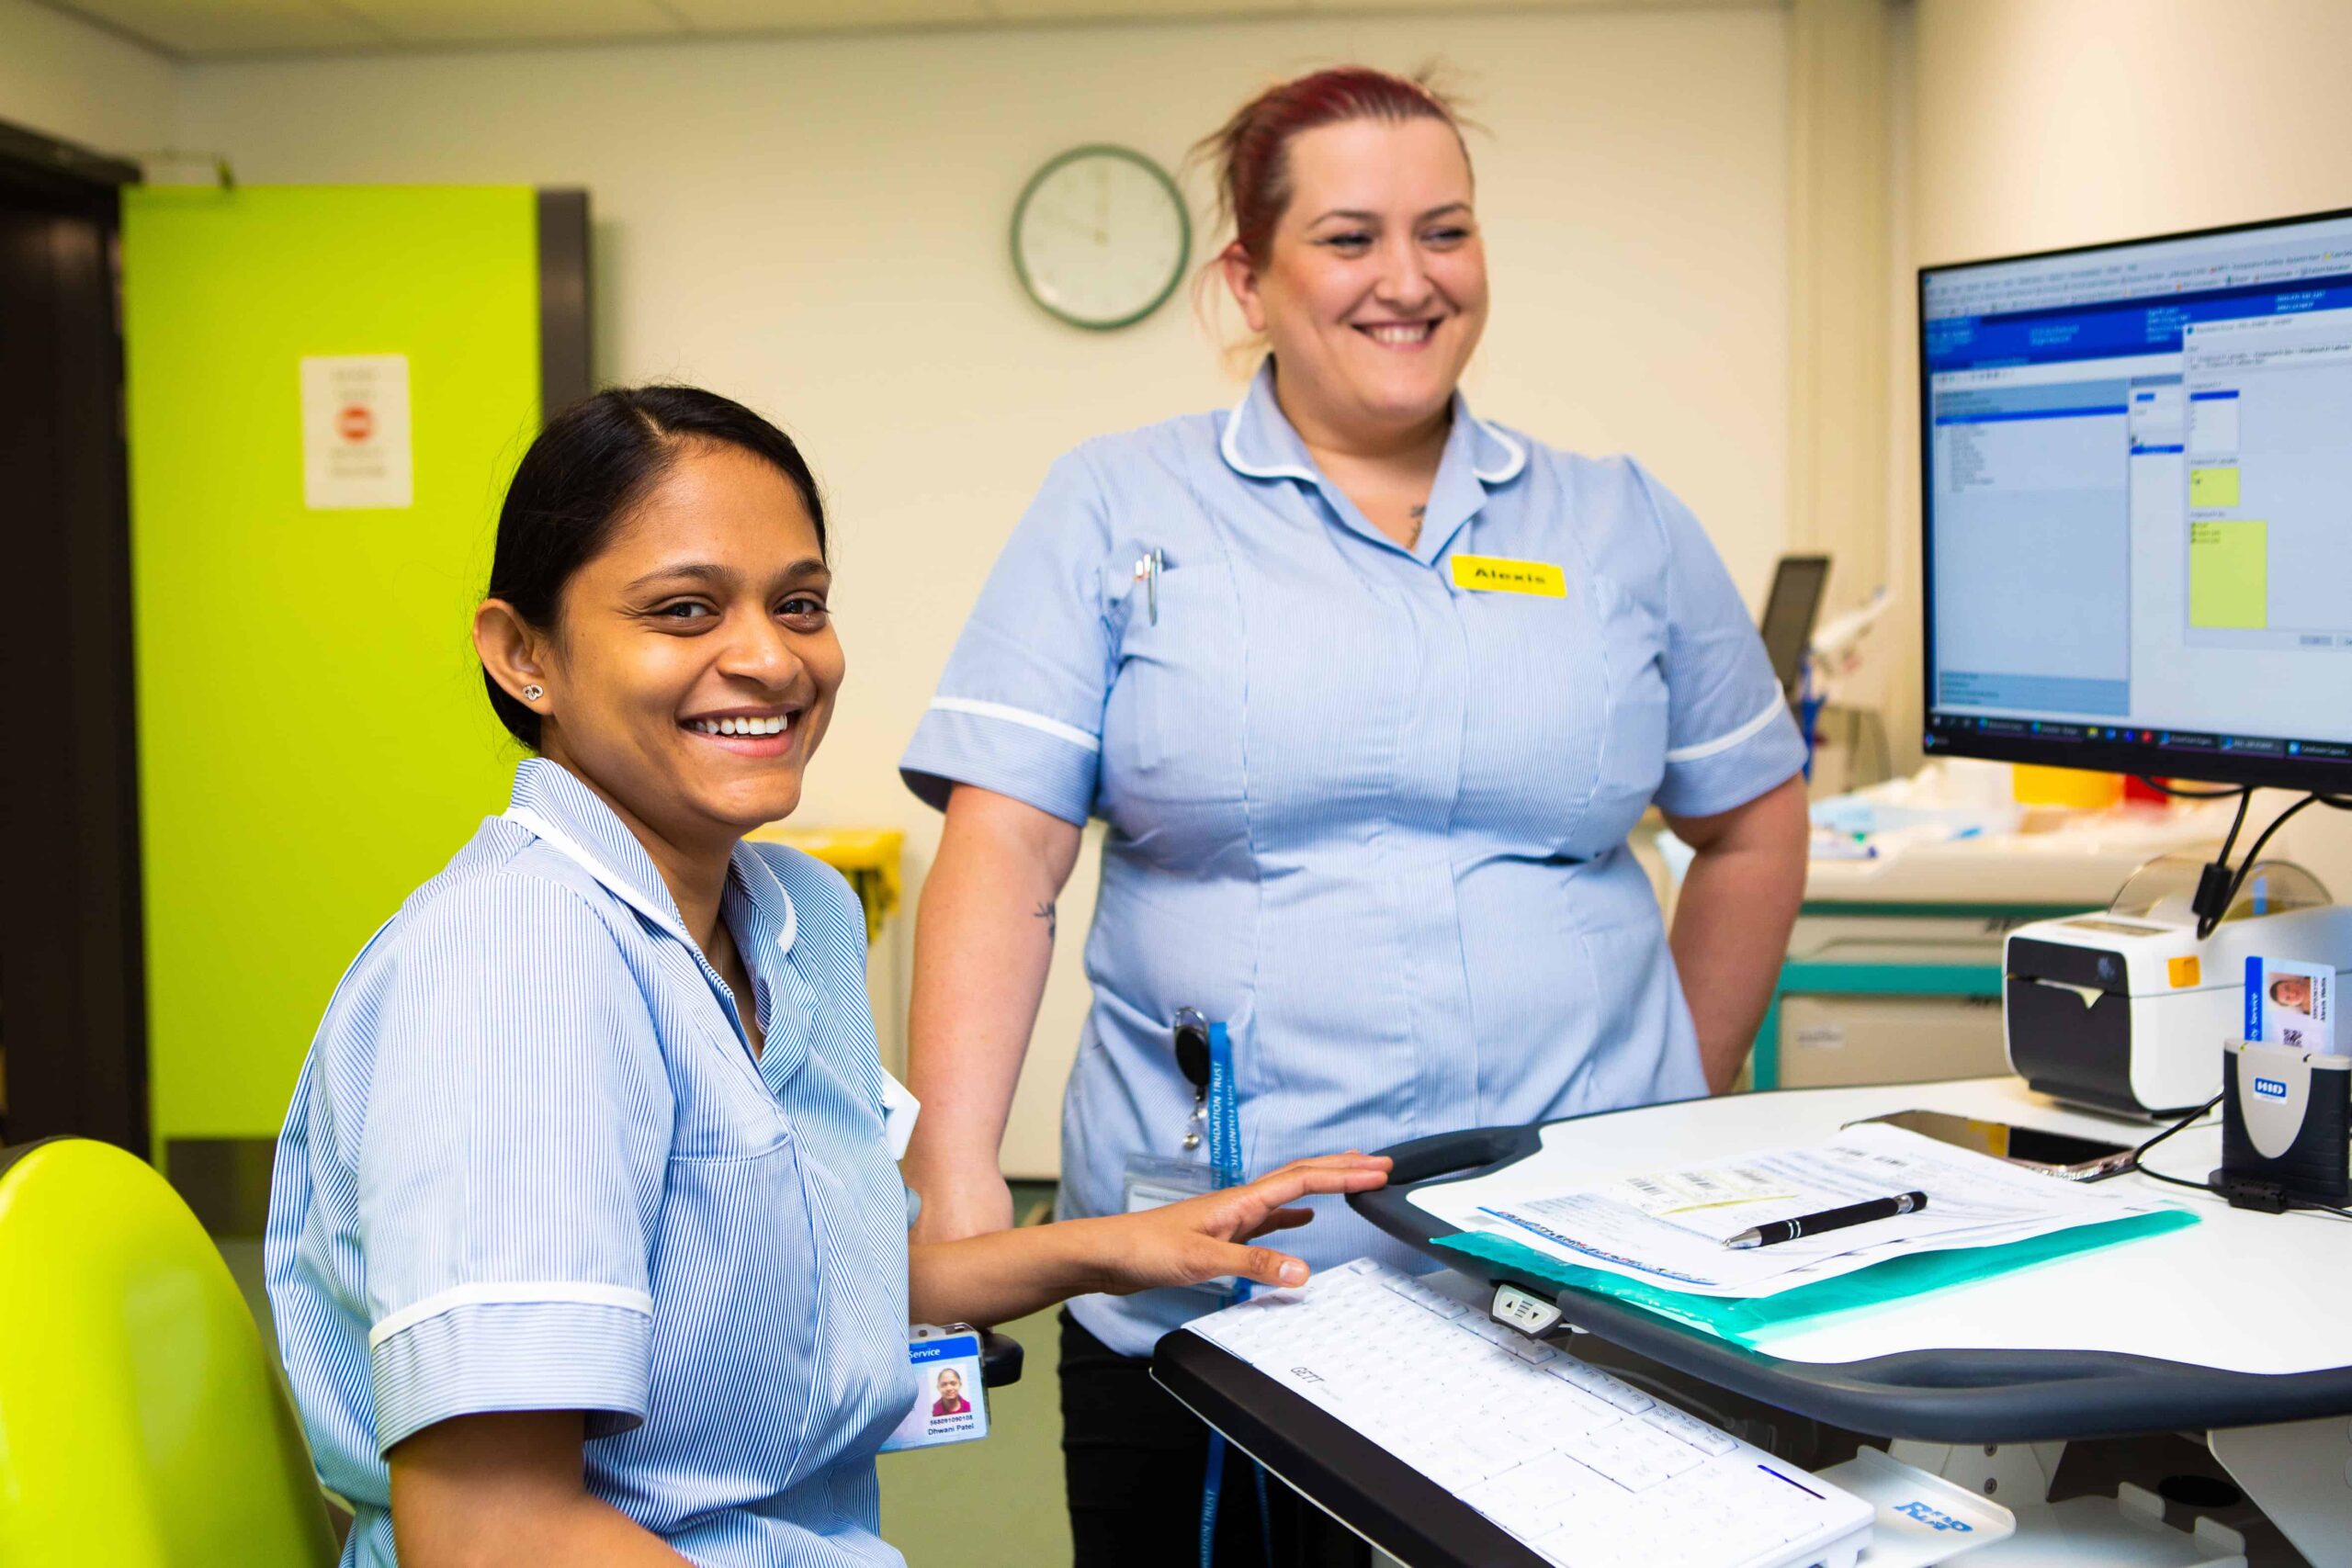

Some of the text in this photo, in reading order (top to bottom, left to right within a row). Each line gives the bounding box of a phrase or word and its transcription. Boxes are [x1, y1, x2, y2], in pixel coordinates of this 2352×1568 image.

[1475, 567, 1546, 585] Alexis
[1213, 1062, 1222, 1093] TRUST
[1212, 1096, 1222, 1165] FOUNDATION
[909, 1348, 941, 1359] Service
[1290, 1366, 1325, 1383] GETT
[928, 1423, 975, 1436] Dhwani Patel
